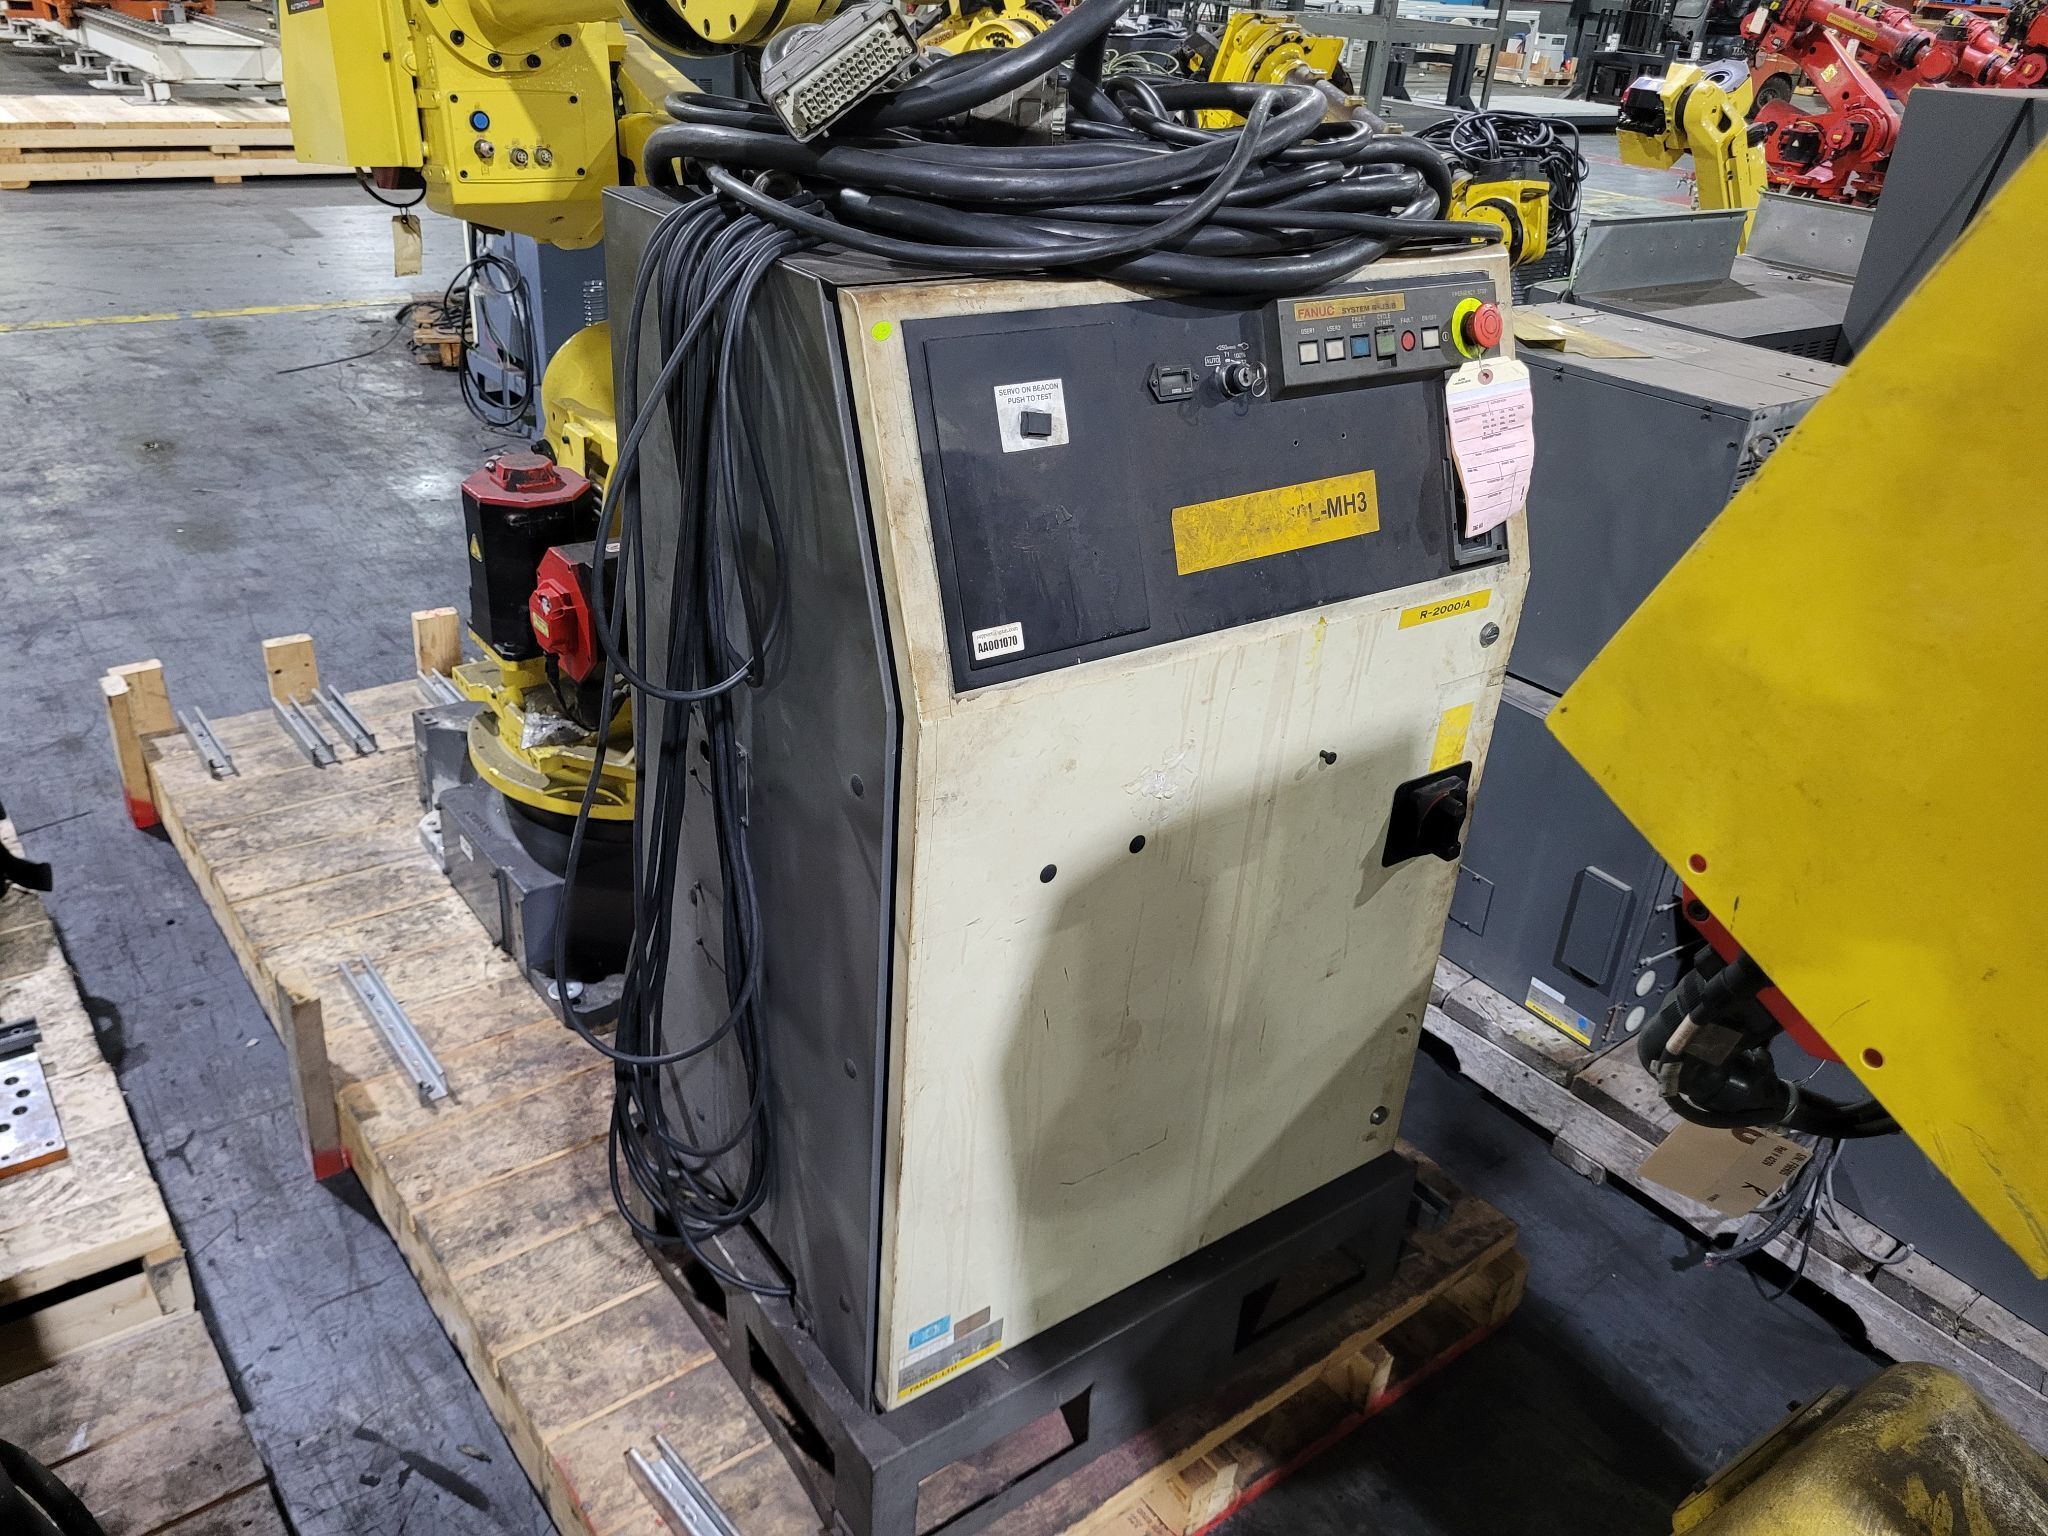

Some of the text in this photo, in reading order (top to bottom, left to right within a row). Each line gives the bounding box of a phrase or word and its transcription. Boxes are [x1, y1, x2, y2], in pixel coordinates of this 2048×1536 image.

[1297, 305, 1335, 319] FANUC
[1341, 304, 1370, 314] SYSTEM
[1351, 315, 1366, 323] FAULT
[1400, 316, 1415, 324] FAULT
[1300, 327, 1315, 335] USER1
[1326, 324, 1341, 333] USER2
[1206, 357, 1220, 365] AUTO
[998, 382, 1059, 397] SERVO ON BEACON
[1007, 392, 1053, 405] PUSH TO TEST
[978, 634, 1018, 654] AA001070
